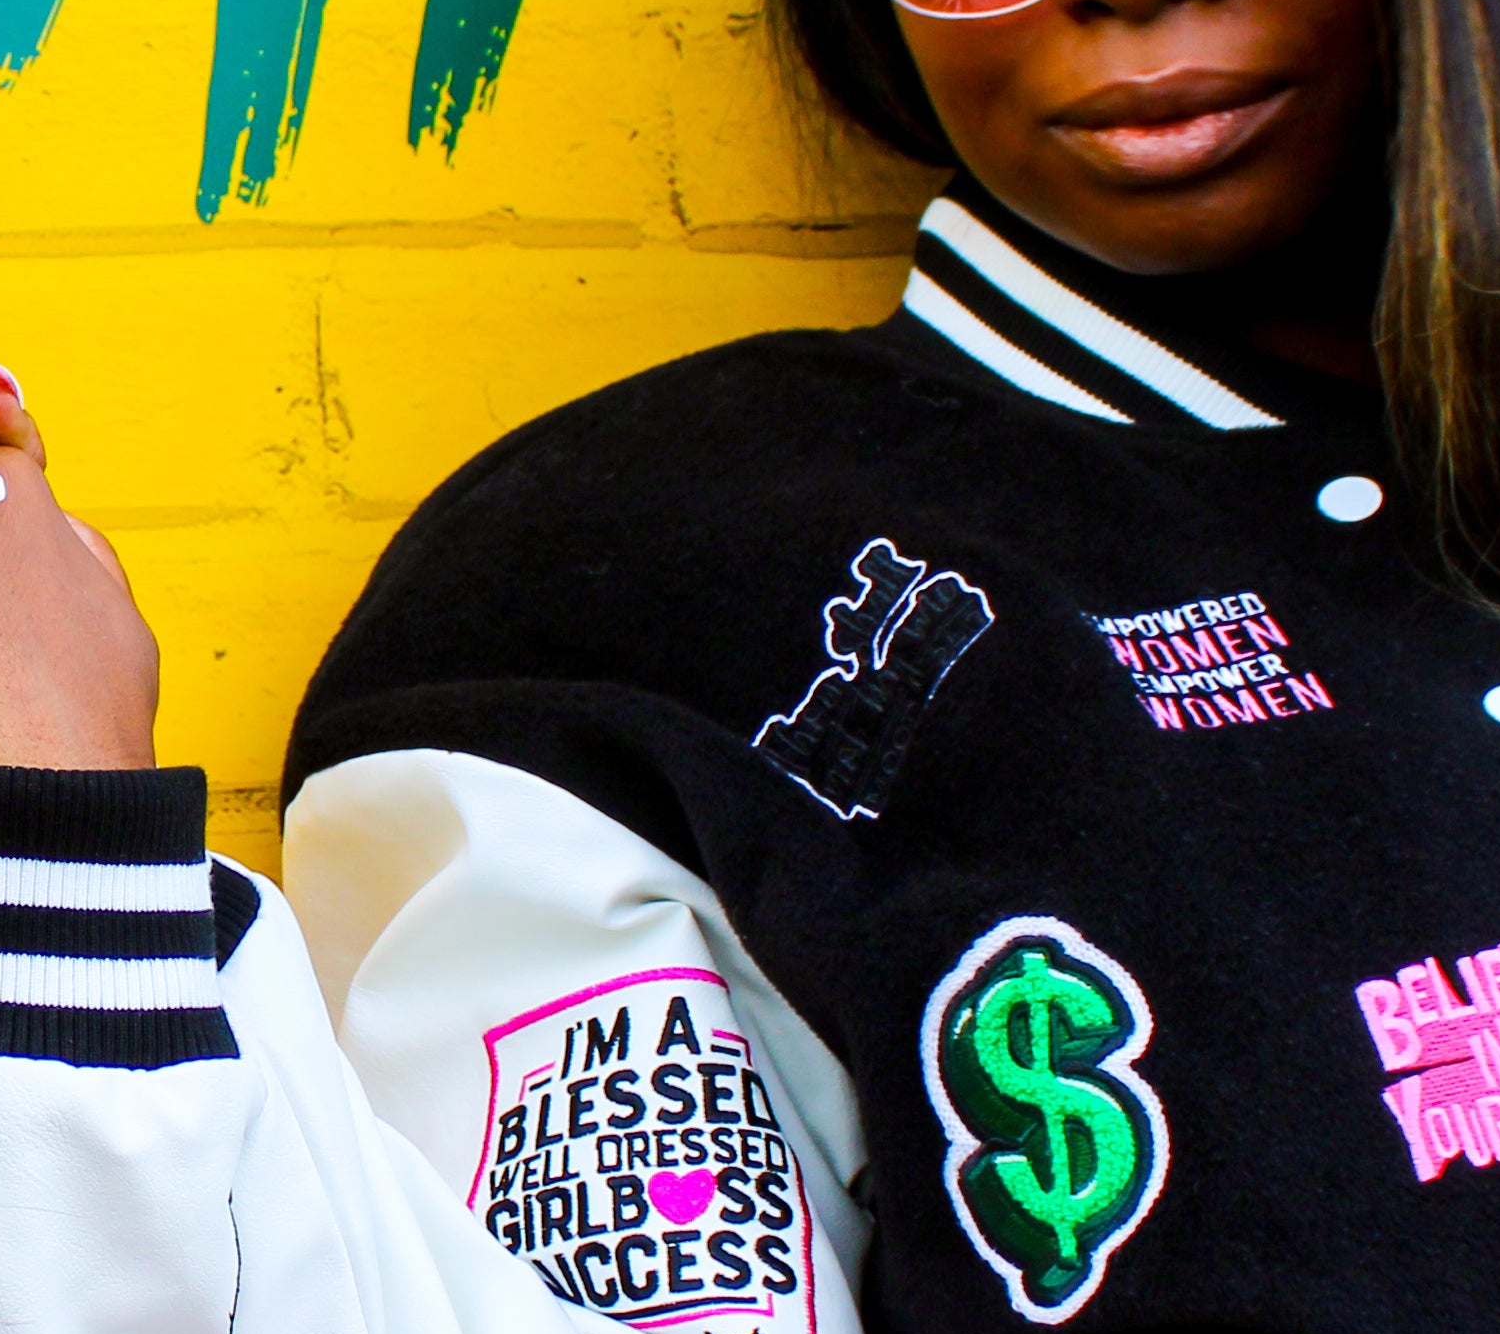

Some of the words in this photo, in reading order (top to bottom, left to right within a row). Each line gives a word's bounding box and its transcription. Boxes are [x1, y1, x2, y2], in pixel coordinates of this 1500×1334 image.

[1084, 592, 1266, 638] MPOWERED
[1107, 615, 1291, 674] WOMEN
[1131, 653, 1289, 695] EMPOWER
[1136, 671, 1335, 731] WOMEN
[561, 1006, 631, 1080] I'M
[656, 996, 702, 1056] A
[495, 1062, 782, 1166] BLESSED
[490, 1144, 580, 1201] WELL
[596, 1127, 790, 1174] DRESSED
